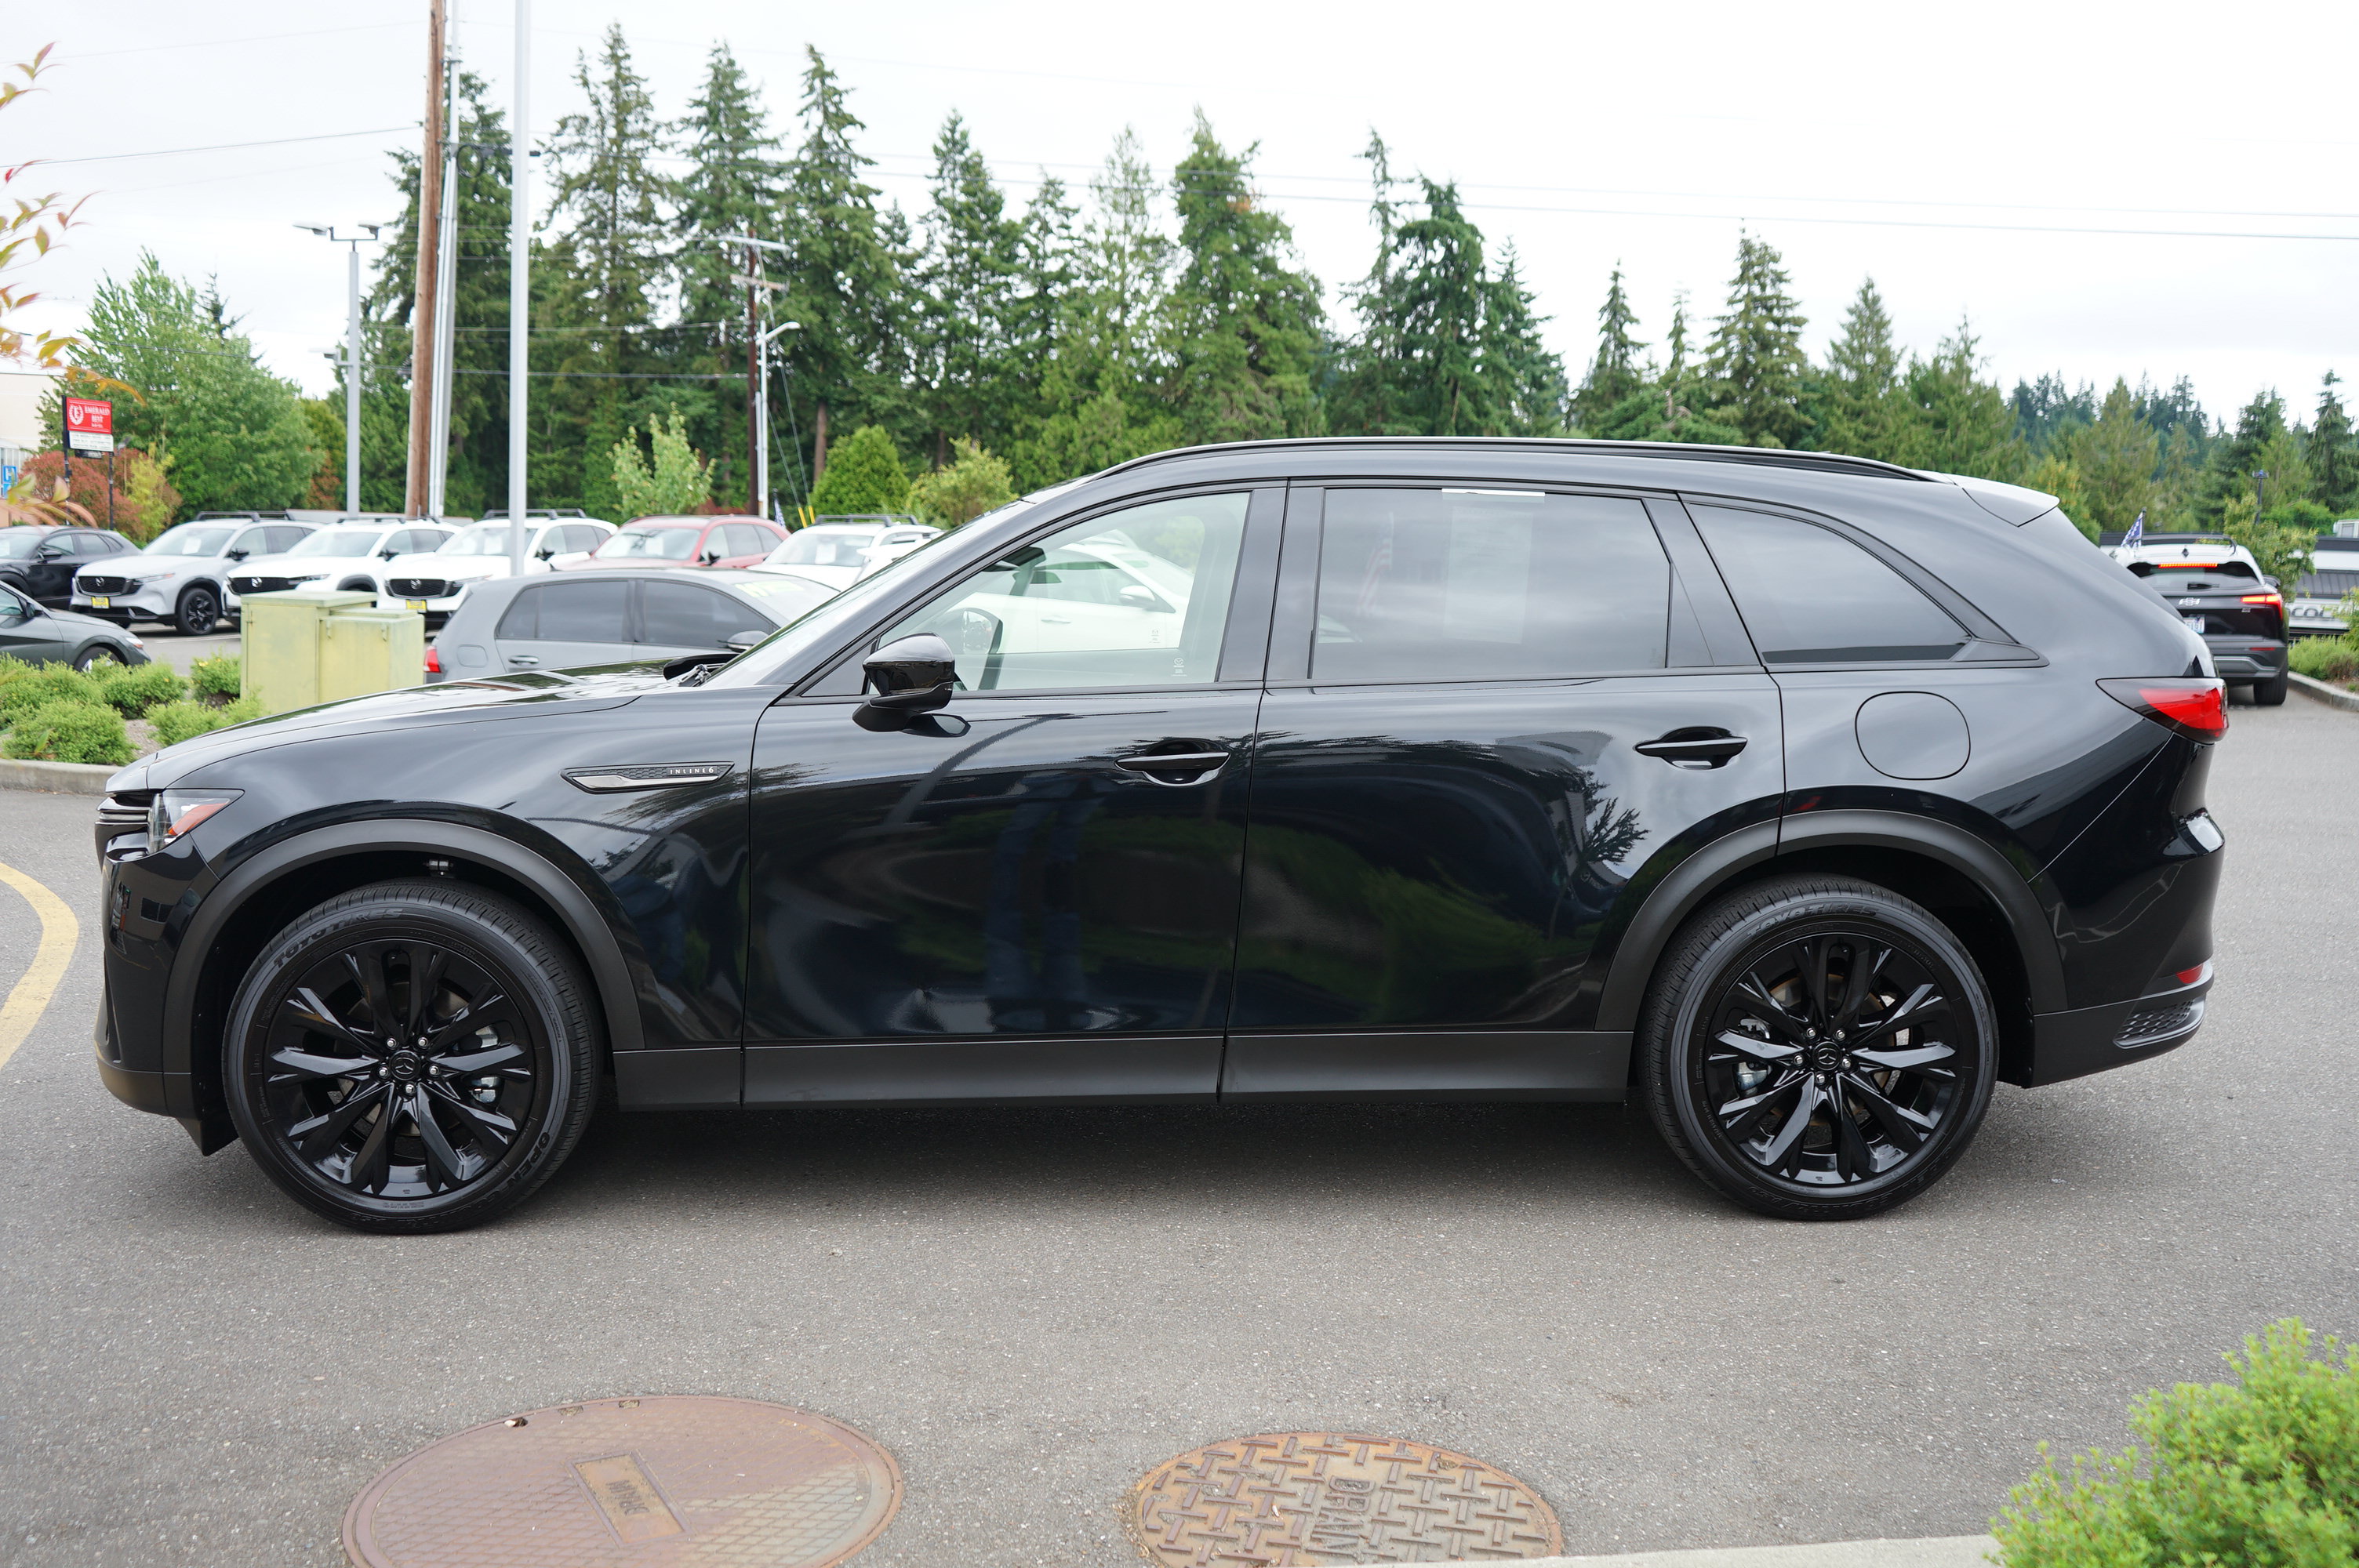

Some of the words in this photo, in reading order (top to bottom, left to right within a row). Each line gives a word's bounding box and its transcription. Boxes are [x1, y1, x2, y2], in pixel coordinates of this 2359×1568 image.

[273, 928, 326, 968] TOYO
[329, 909, 403, 931] TIRES
[1747, 907, 1805, 937] TOYO
[1808, 903, 1880, 916] TIRES
[1306, 1475, 1376, 1555] DRAIN
